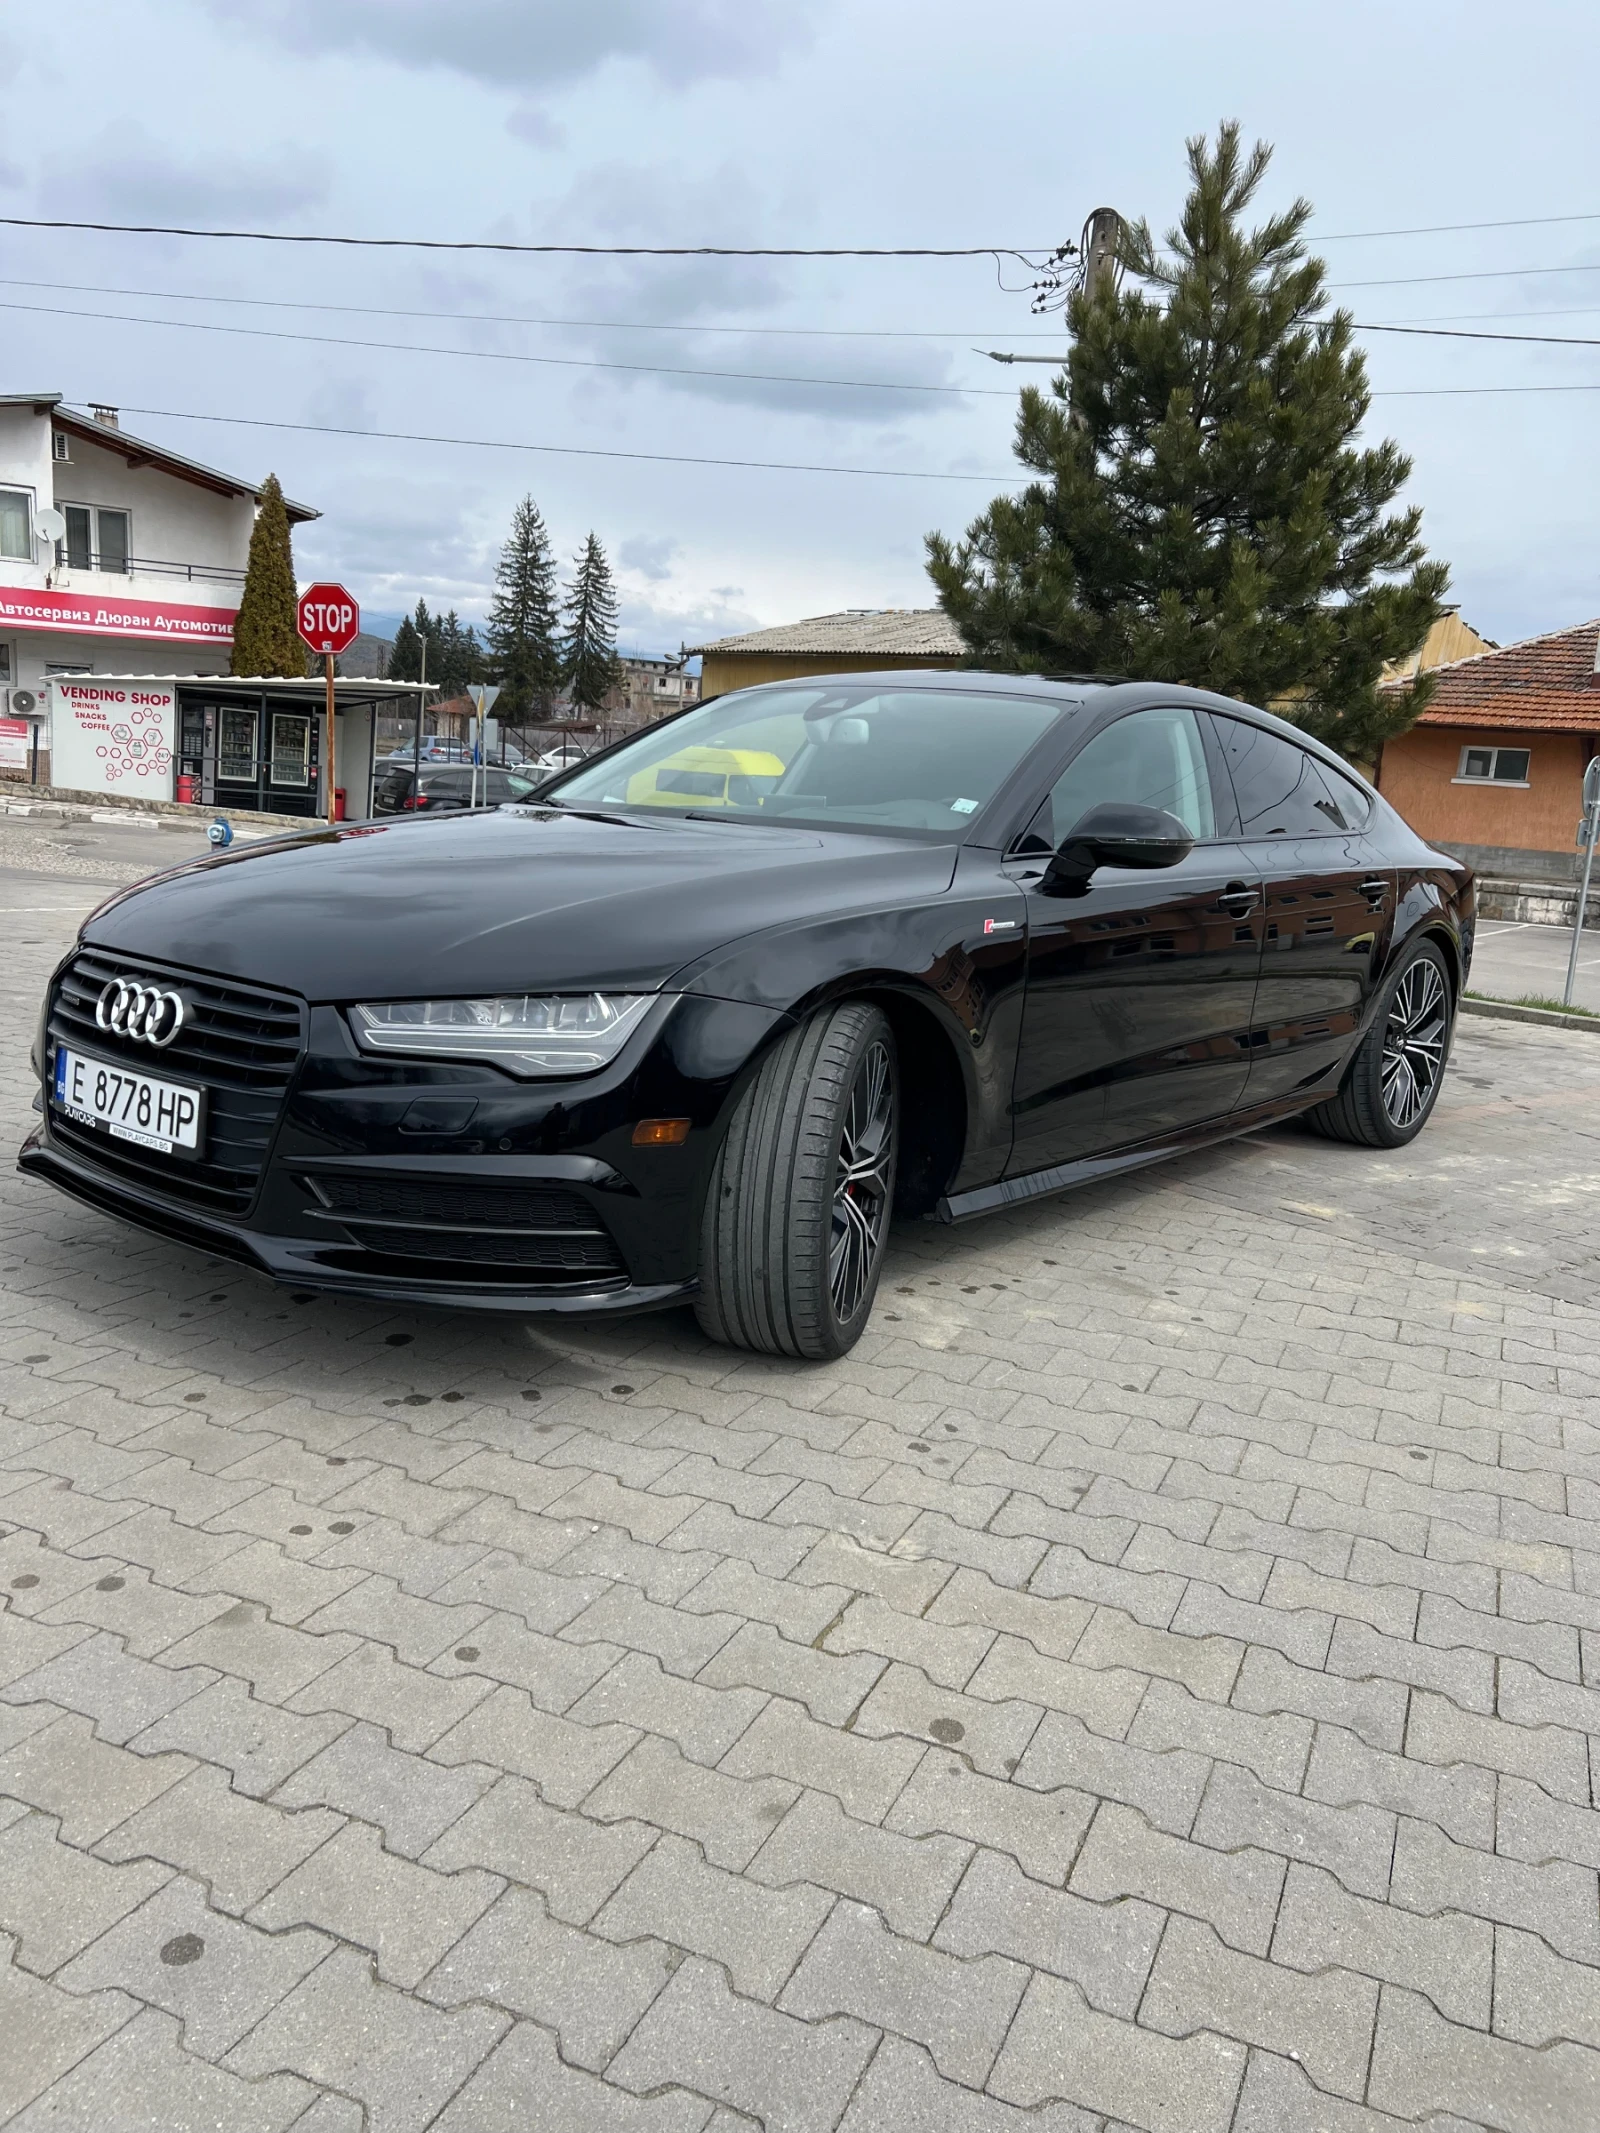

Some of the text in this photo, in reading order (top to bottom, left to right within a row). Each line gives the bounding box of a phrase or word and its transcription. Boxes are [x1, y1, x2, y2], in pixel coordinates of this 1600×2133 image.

[95, 610, 150, 627] Дюран
[303, 603, 353, 633] STOP
[60, 686, 171, 707] VENDING SHOP
[71, 702, 100, 710] DRINKS
[75, 712, 107, 721] SNACKS
[81, 722, 110, 731] COFFEE
[57, 1080, 65, 1095] BG
[72, 1059, 195, 1138] E 8778 HP
